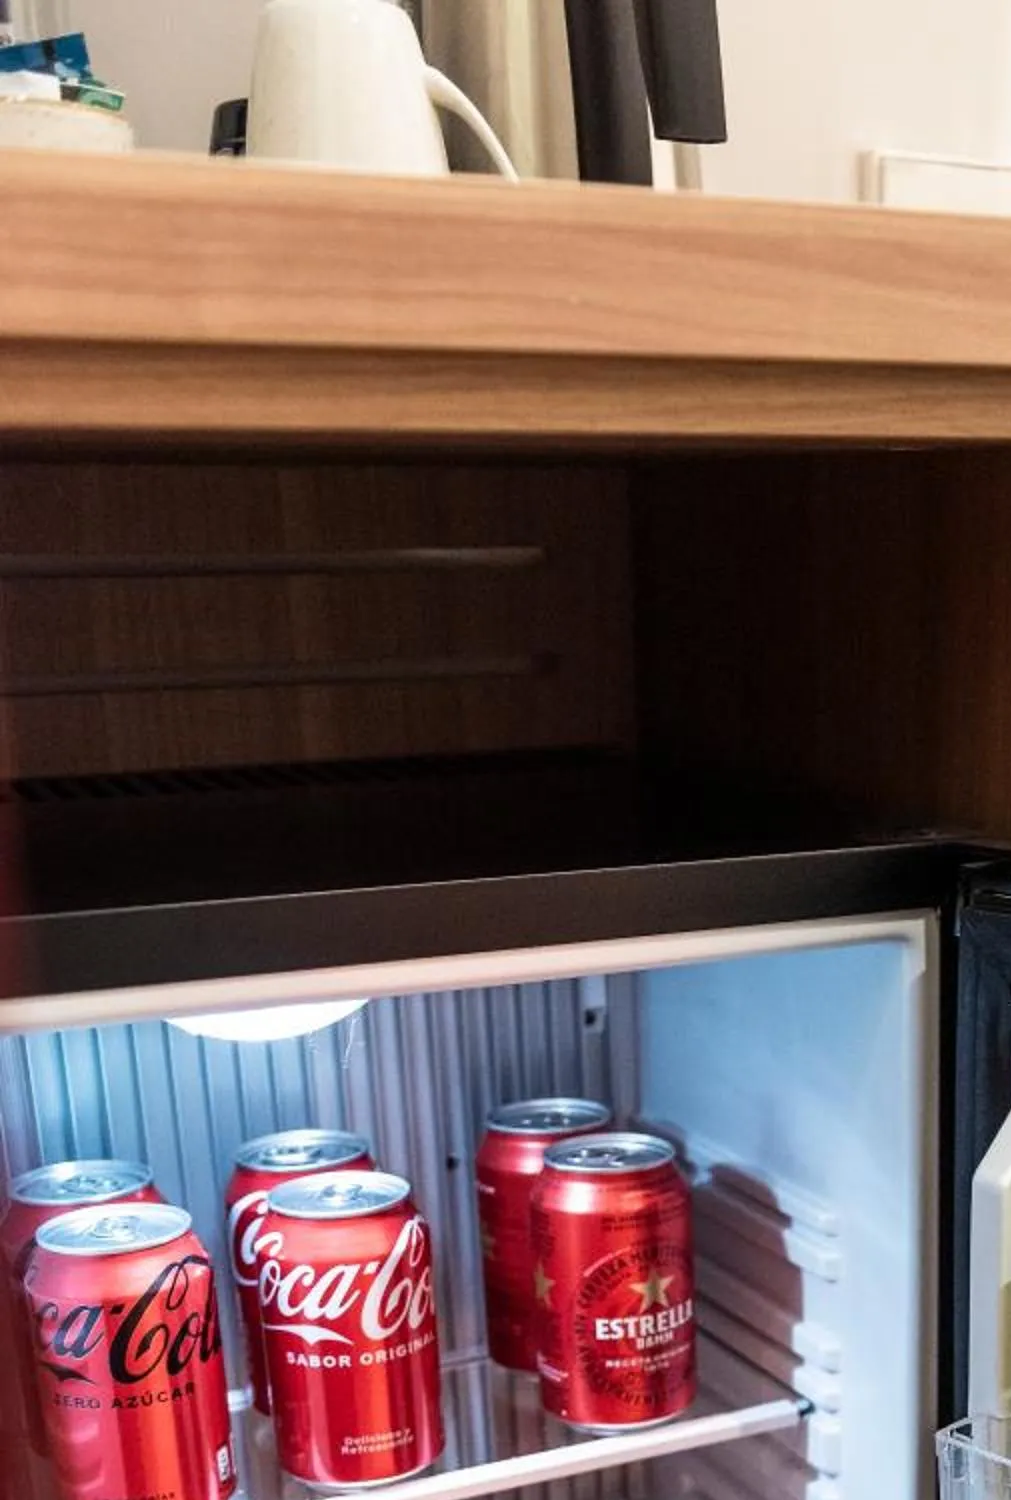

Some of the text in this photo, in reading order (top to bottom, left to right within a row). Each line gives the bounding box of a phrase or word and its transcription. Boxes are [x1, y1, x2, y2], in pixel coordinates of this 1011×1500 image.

[286, 1331, 435, 1368] SABOR ORIGINAL
[111, 1382, 195, 1408] AZÚCAR
